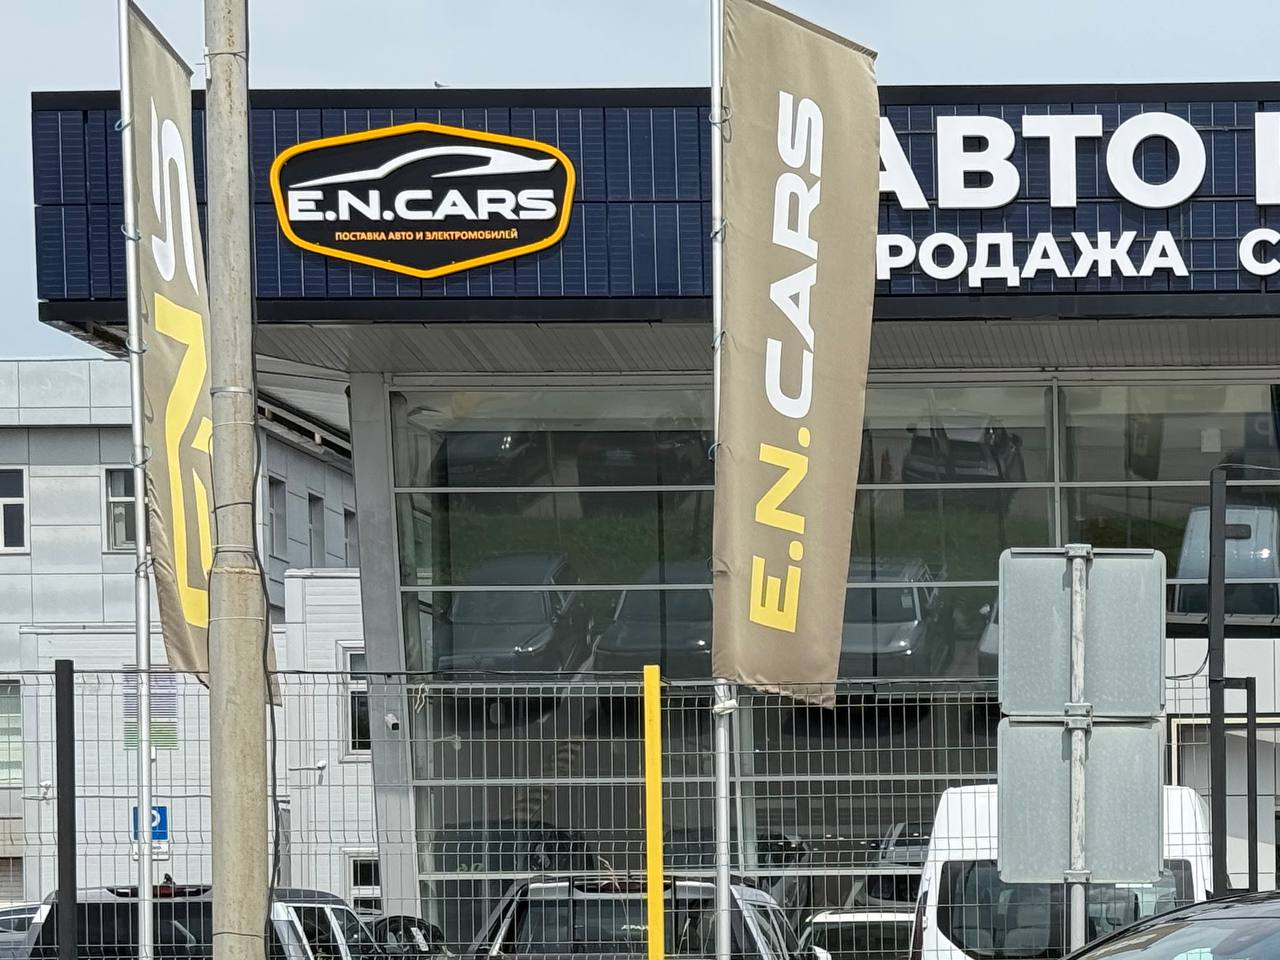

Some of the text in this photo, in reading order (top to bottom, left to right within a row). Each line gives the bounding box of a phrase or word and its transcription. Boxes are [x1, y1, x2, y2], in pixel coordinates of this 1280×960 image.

[288, 189, 557, 221] E.N.CARS
[335, 228, 518, 241] ПОСТАВКА АВТО И ЭЛЕКТРОМОБИЛЕЙ
[876, 230, 1189, 288] РОДАЖА
[749, 90, 824, 633] E.N.CARS
